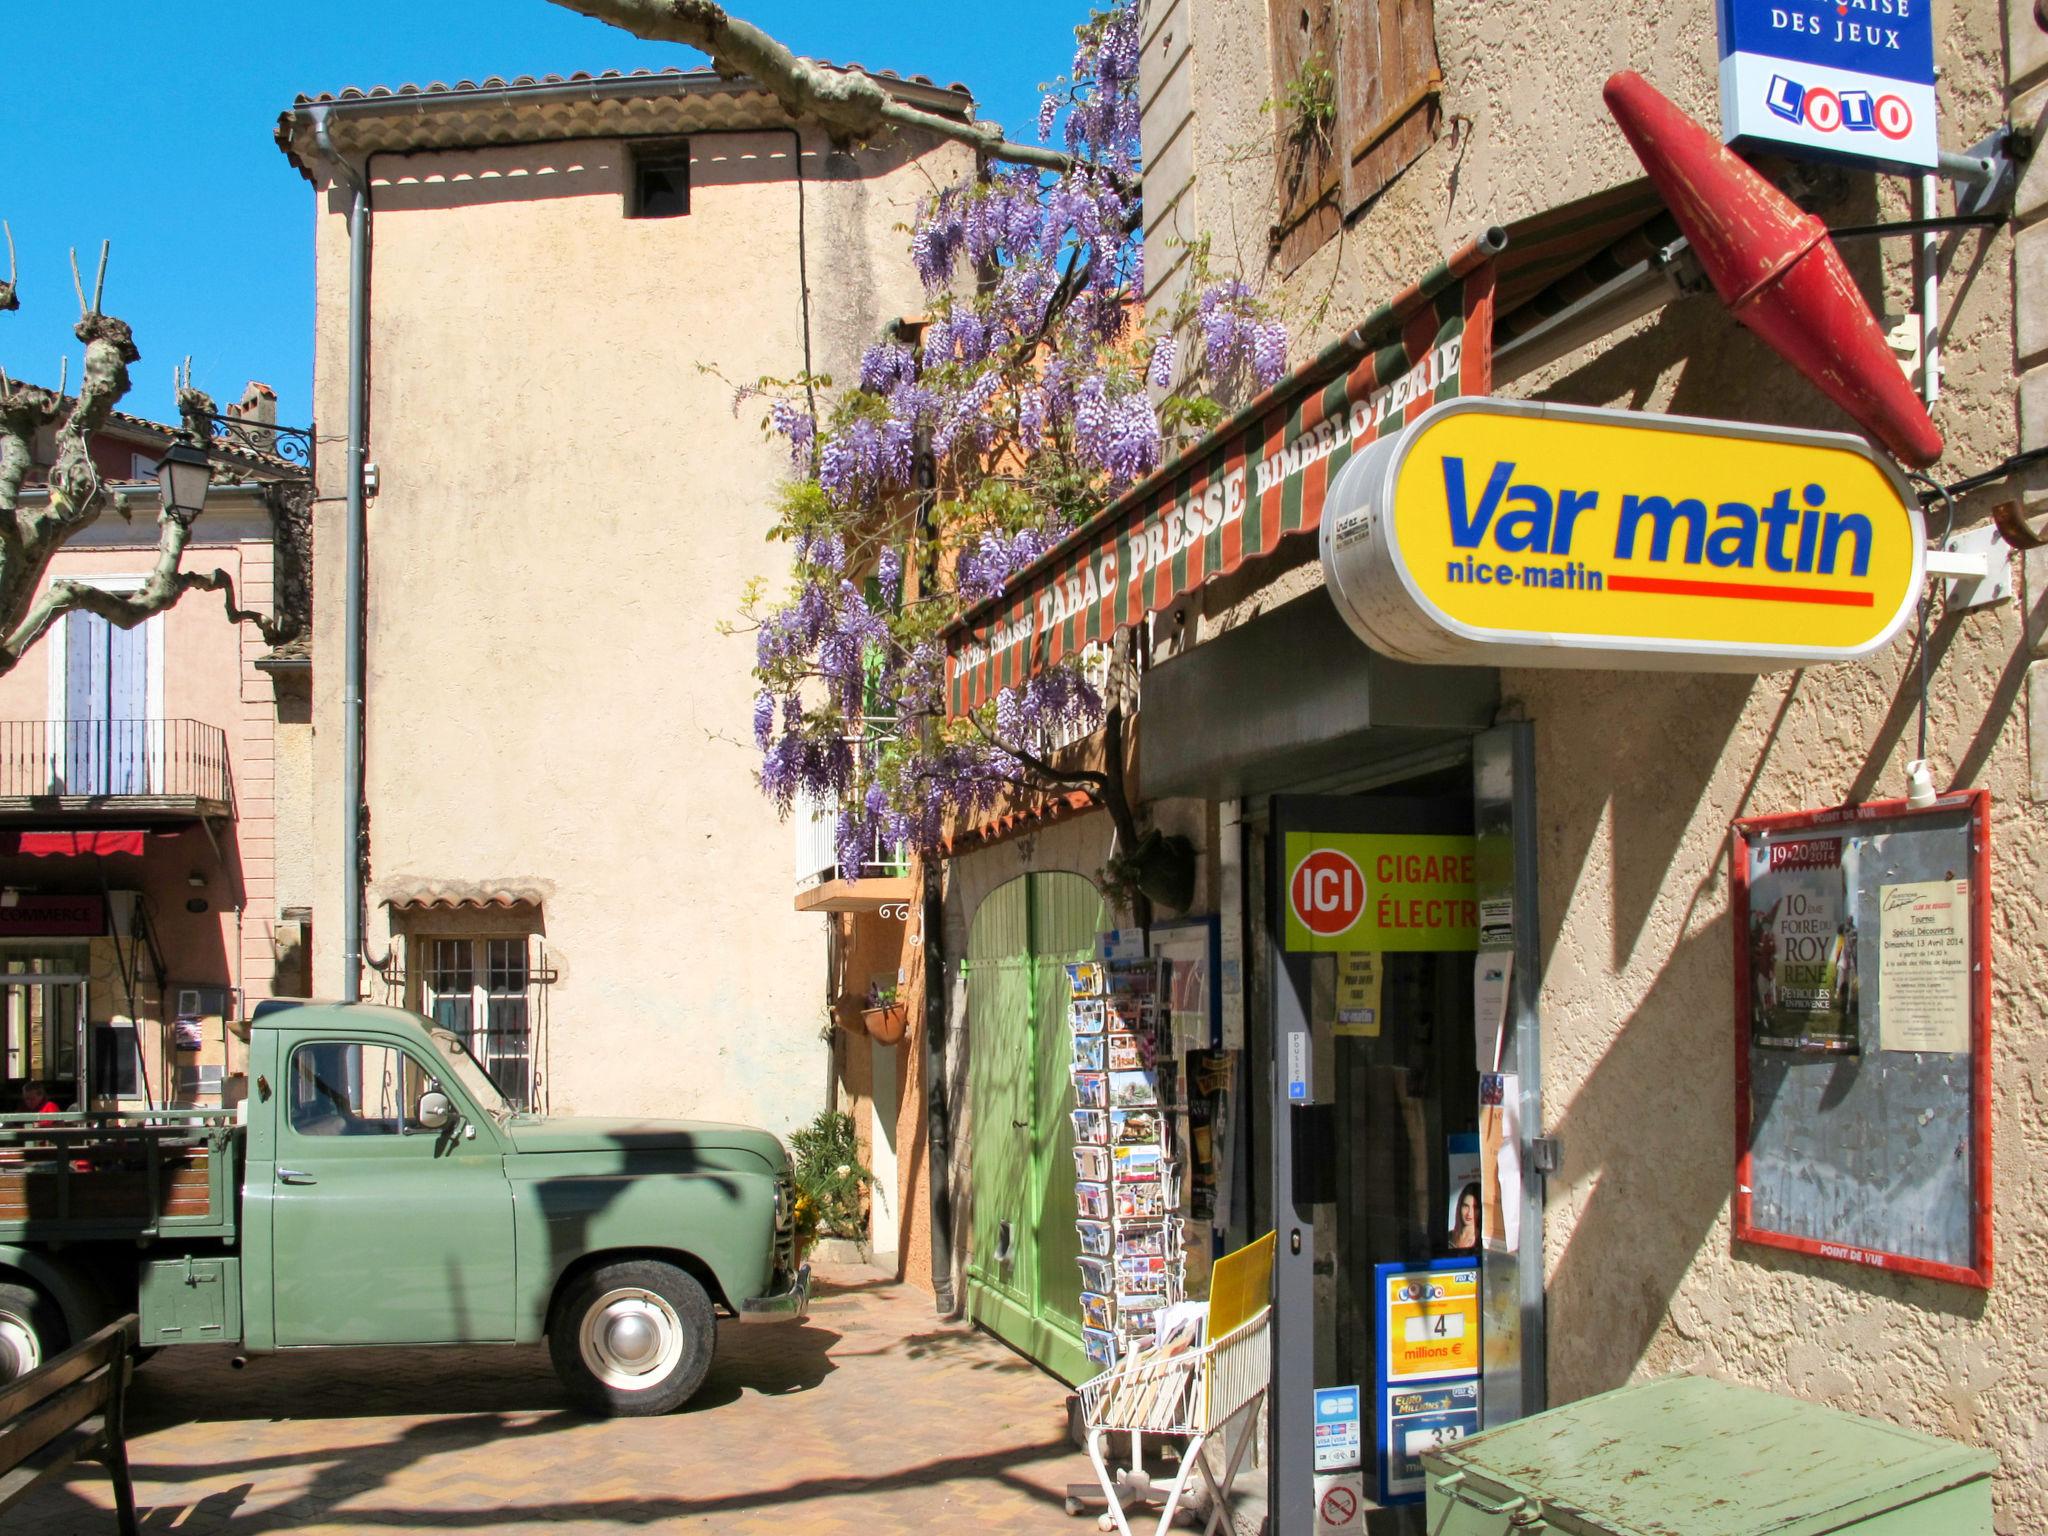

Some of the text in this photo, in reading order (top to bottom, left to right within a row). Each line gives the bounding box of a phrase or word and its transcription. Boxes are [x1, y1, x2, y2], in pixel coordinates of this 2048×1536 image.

[1771, 9, 1900, 50] DES JEUX
[1765, 73, 1913, 141] LOTO
[1039, 553, 1117, 632] TABAC
[1129, 466, 1246, 582] PRESSE
[1255, 334, 1461, 497] BIMBELOTERIE
[1441, 456, 1873, 577] Var matin
[1447, 556, 1603, 592] nice-matin
[1811, 807, 1877, 824] POINT DE VUE
[1809, 850, 1835, 862] 2014
[1303, 868, 1353, 912] ICI
[0, 907, 90, 921] COMMERCE
[1377, 893, 1479, 929] ÉLECTR
[1785, 894, 1807, 916] 10
[1781, 919, 1819, 934] FOIRE
[1785, 936, 1830, 961] ROY
[1884, 937, 1964, 949] Dimanche 13 Avril 2014
[1820, 1244, 1884, 1266] POINT DE VUE
[1434, 1314, 1447, 1337] 4
[1404, 1345, 1448, 1360] millions
[1395, 1395, 1421, 1406] EURO
